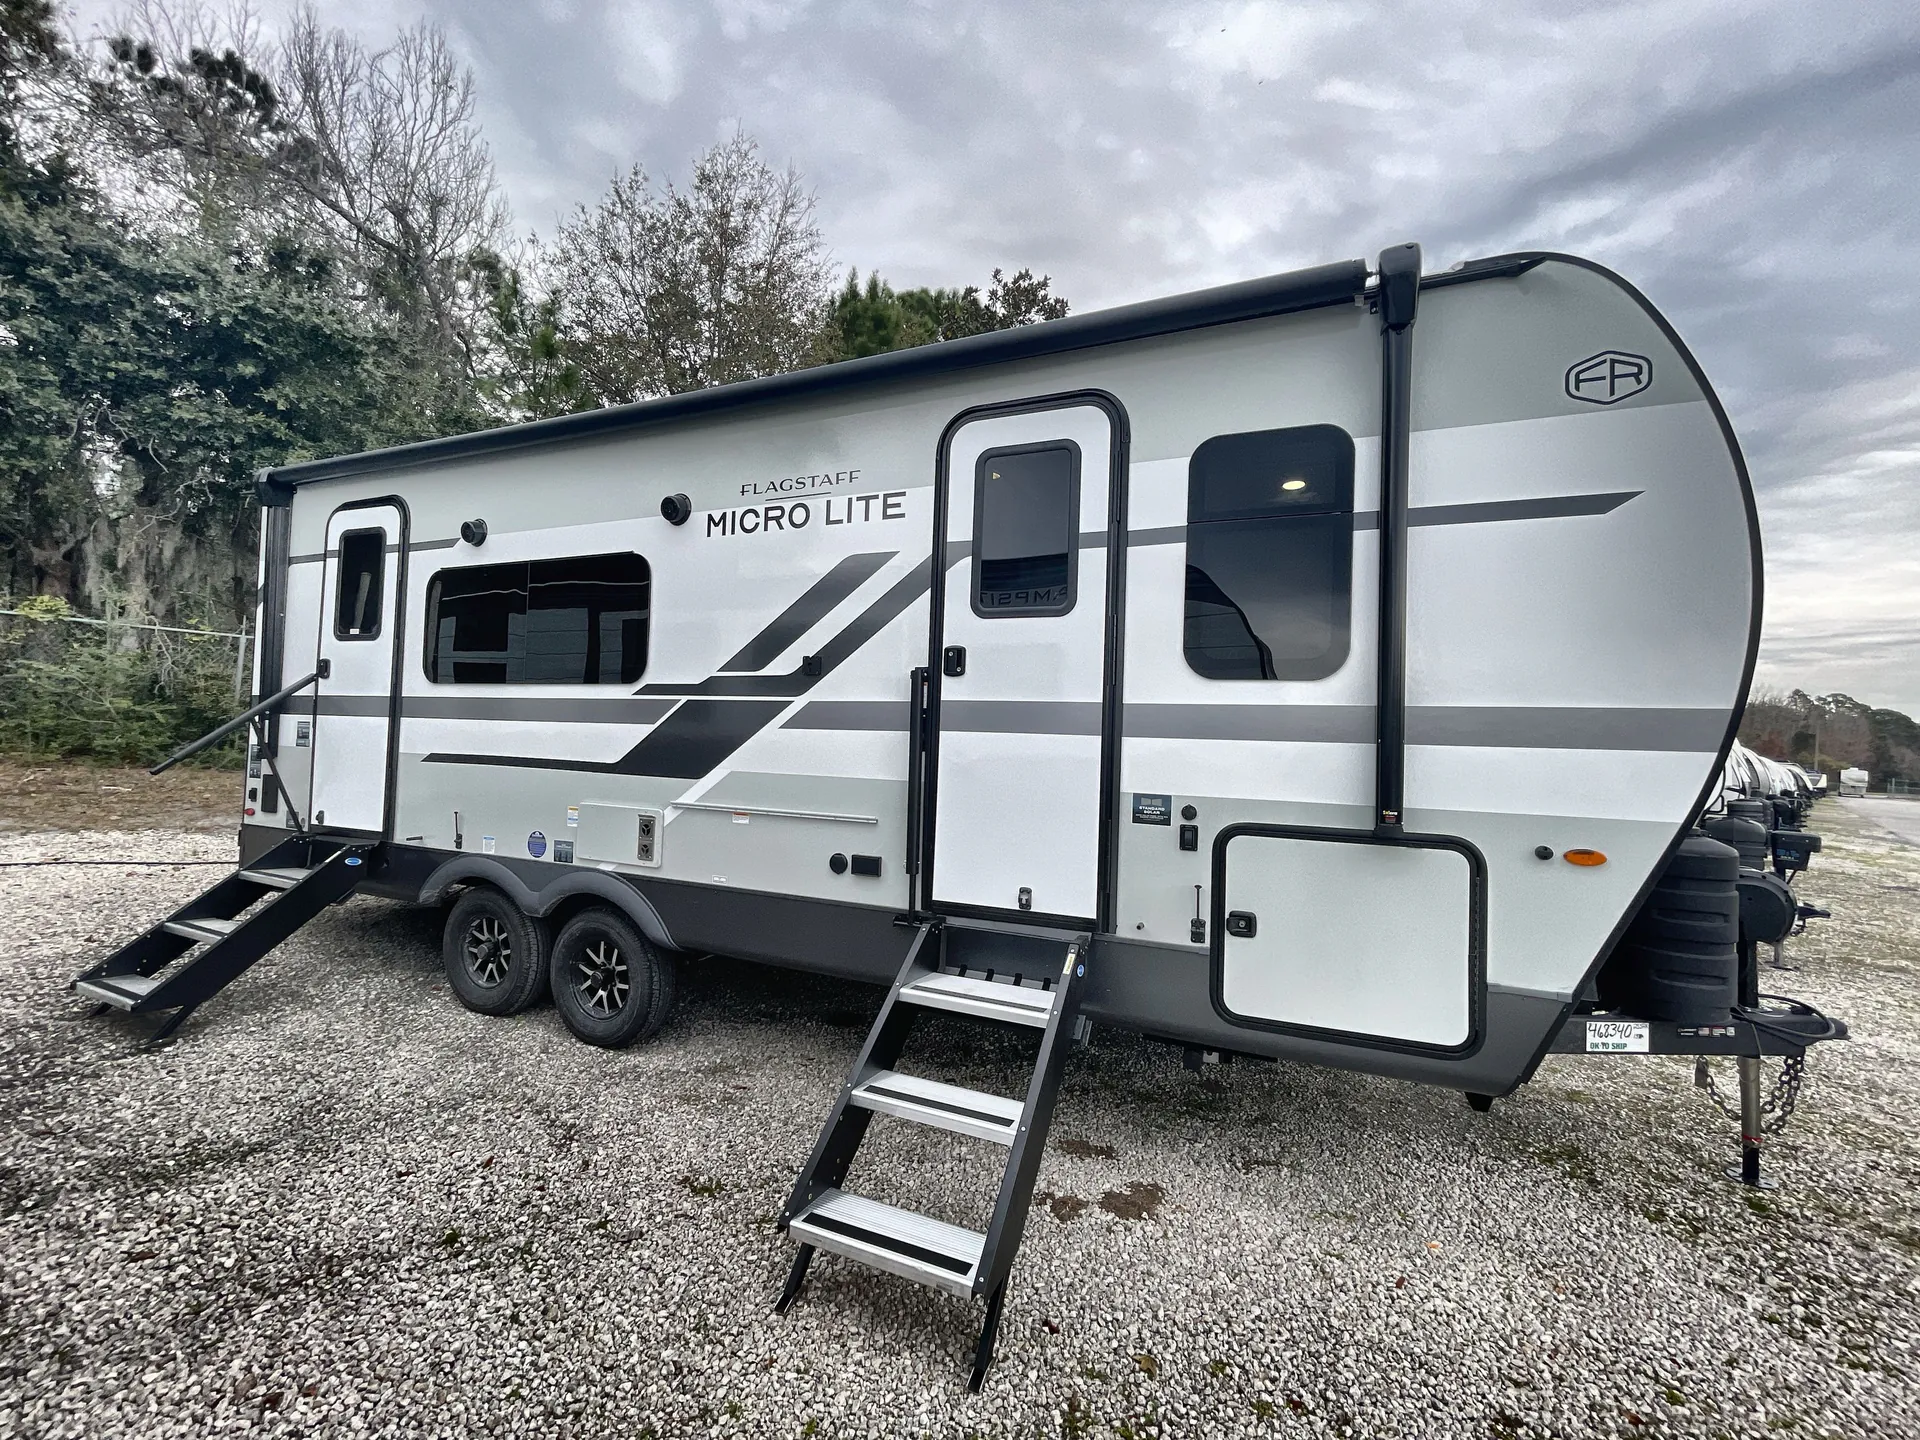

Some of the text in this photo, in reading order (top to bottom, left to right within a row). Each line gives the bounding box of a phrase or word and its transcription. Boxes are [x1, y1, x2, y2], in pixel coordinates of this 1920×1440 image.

[740, 469, 861, 496] FLAGSTAFF
[706, 491, 907, 538] MICRO LITE
[1587, 1022, 1633, 1039] 468340
[1590, 1042, 1600, 1050] OK
[1611, 1042, 1628, 1050] SHIP
